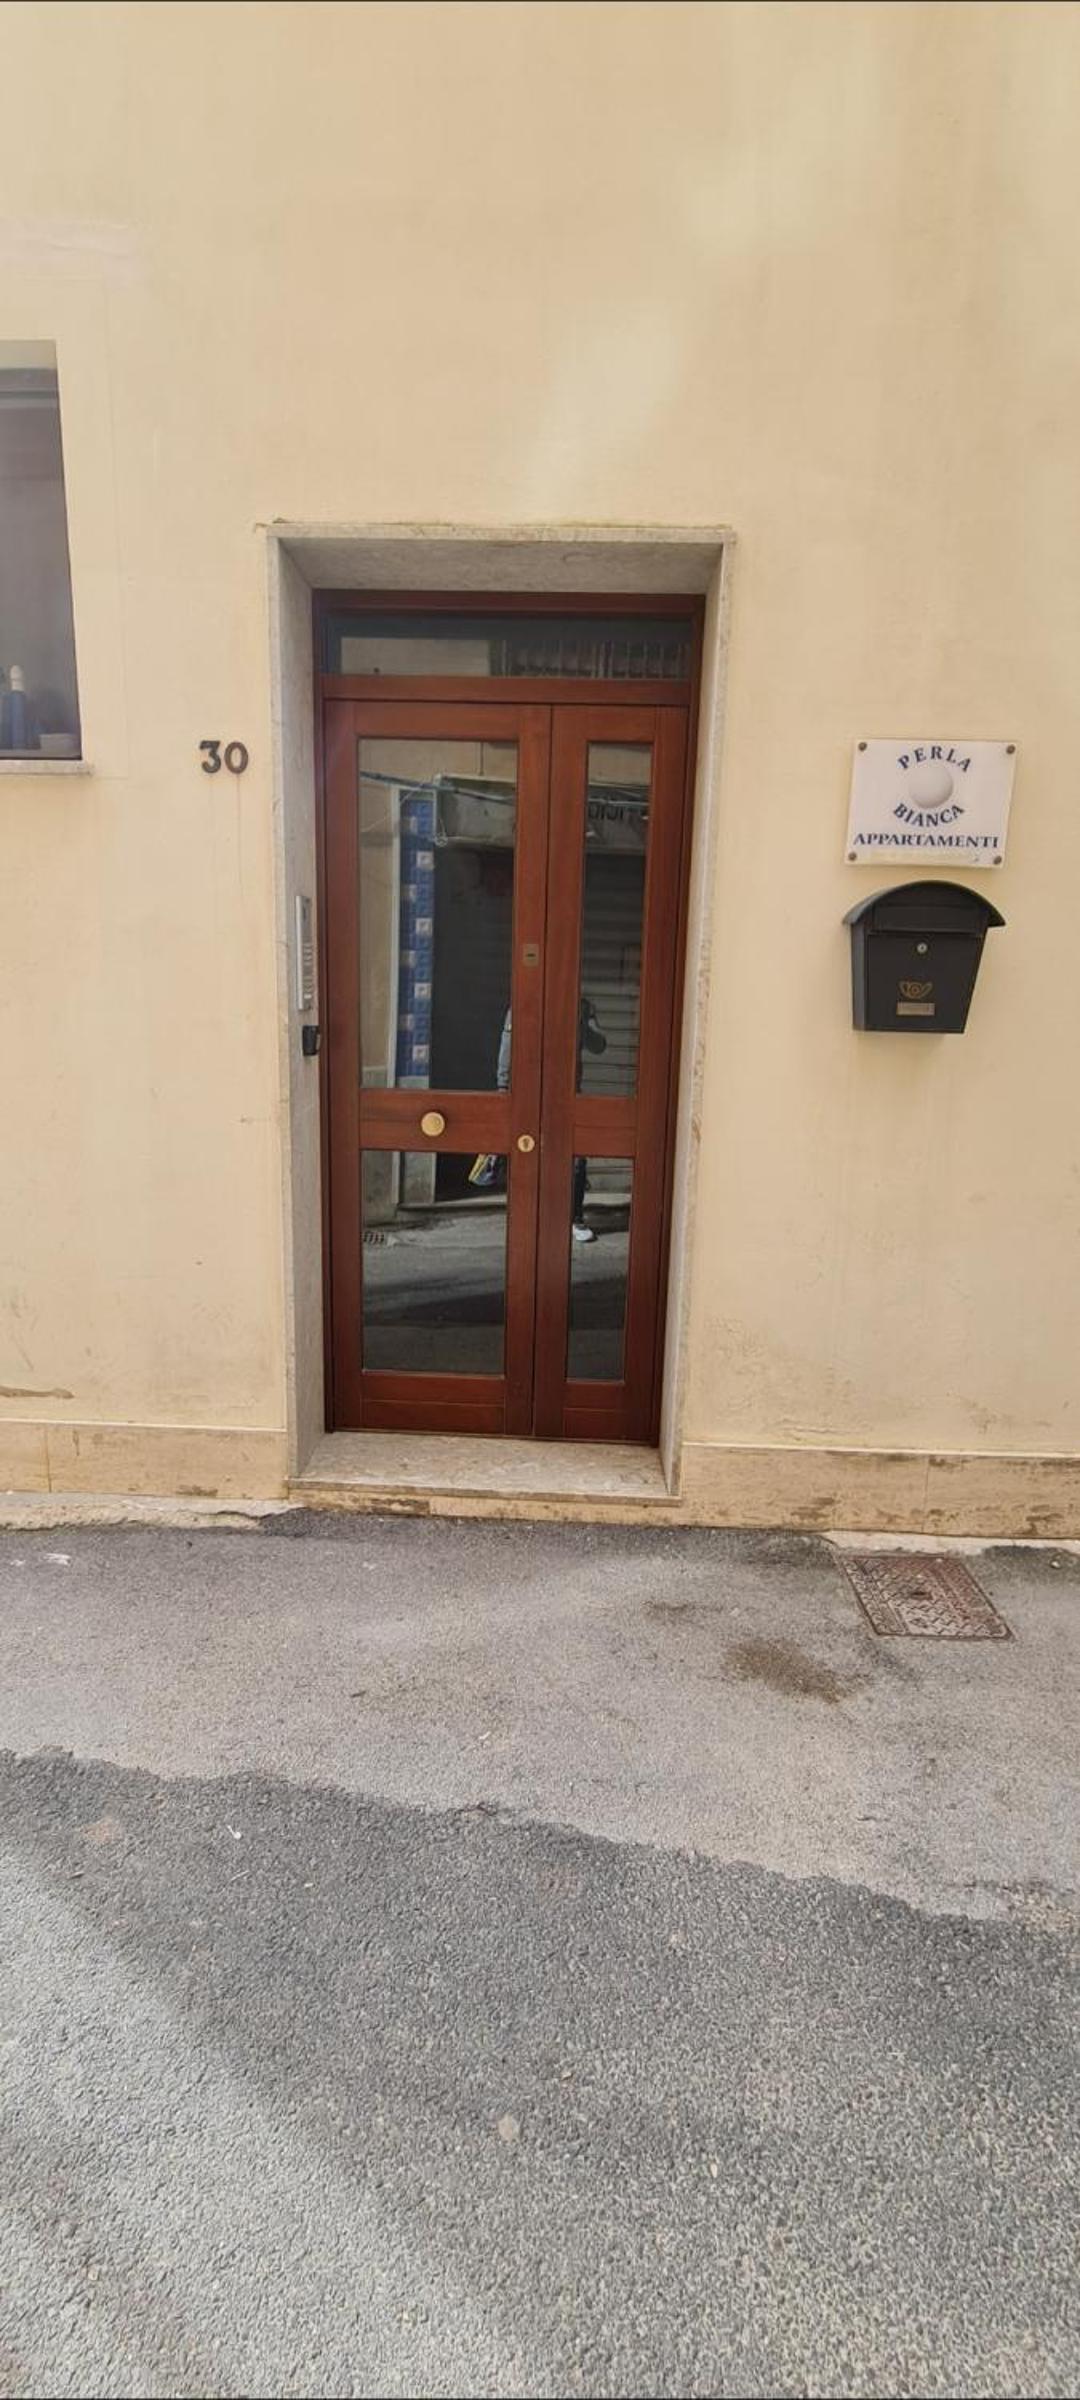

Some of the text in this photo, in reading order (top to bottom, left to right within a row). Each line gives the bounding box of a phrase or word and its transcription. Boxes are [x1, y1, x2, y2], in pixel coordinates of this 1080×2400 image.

[199, 740, 249, 774] 30
[898, 745, 971, 772] PERLA
[893, 803, 965, 827] BIANCA
[853, 832, 999, 848] APPARTAMENTI
